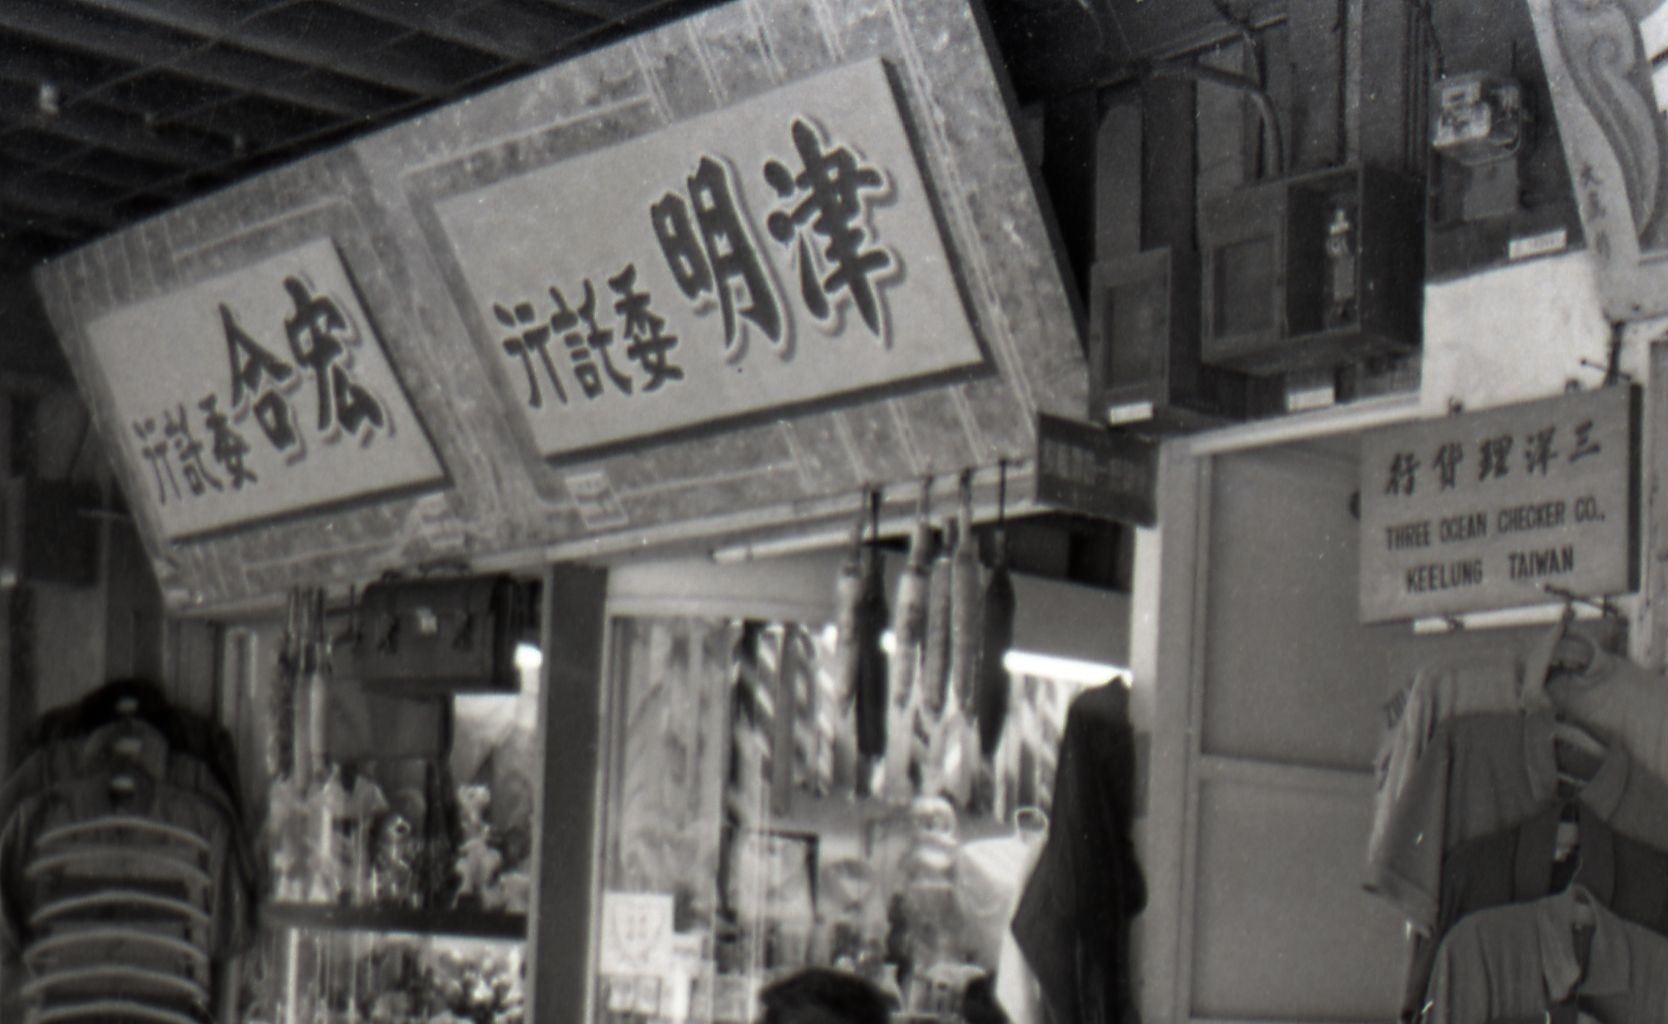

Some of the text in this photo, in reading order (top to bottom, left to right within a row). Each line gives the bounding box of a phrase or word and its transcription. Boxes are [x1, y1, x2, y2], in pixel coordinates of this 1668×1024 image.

[1386, 523, 1431, 551] THREE
[1440, 513, 1487, 543] OCEAN
[1499, 502, 1566, 534] CHECKER
[1407, 547, 1575, 593] KEELUNG TAIWAN
